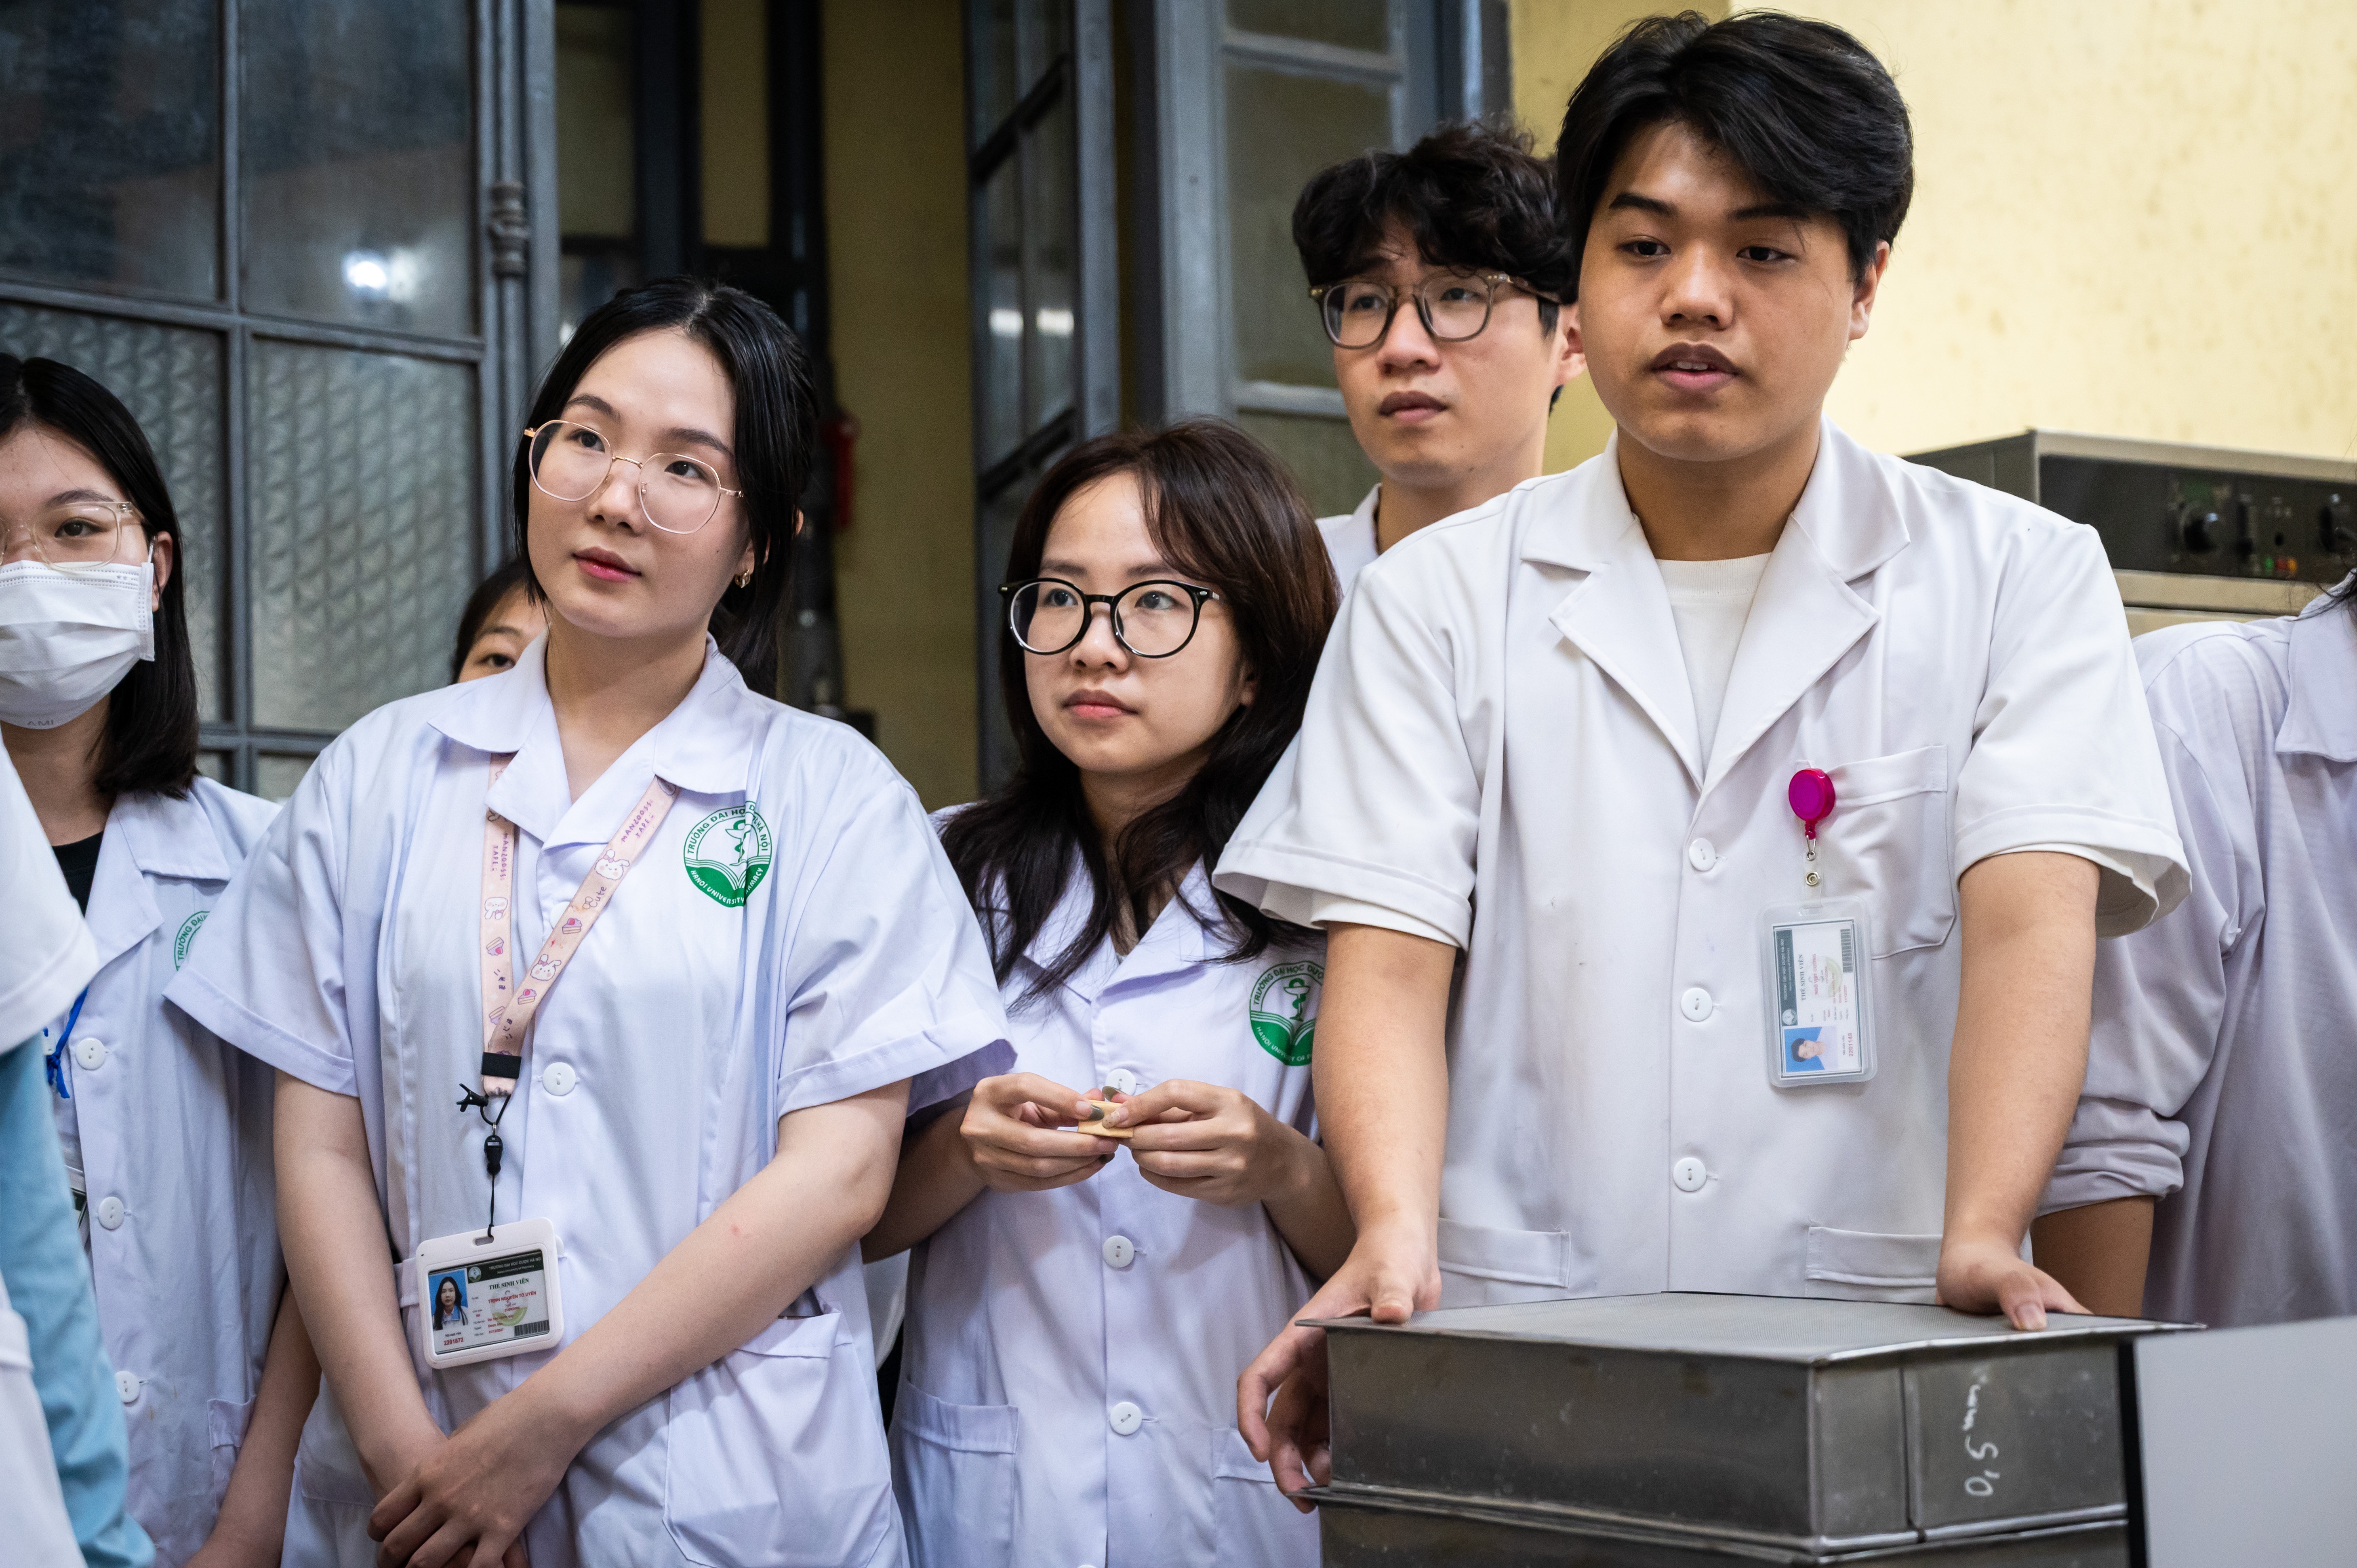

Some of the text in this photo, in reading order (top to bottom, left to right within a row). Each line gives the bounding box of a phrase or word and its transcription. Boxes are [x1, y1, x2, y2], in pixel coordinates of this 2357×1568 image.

[688, 823, 710, 853] TRƯỜNG
[760, 834, 770, 851] NỘI
[589, 886, 607, 908] Cute
[690, 870, 707, 888] HANOI
[707, 887, 744, 904] UNIVERSITY
[1256, 1026, 1271, 1046] HANOI
[443, 1337, 464, 1345] 2201872
